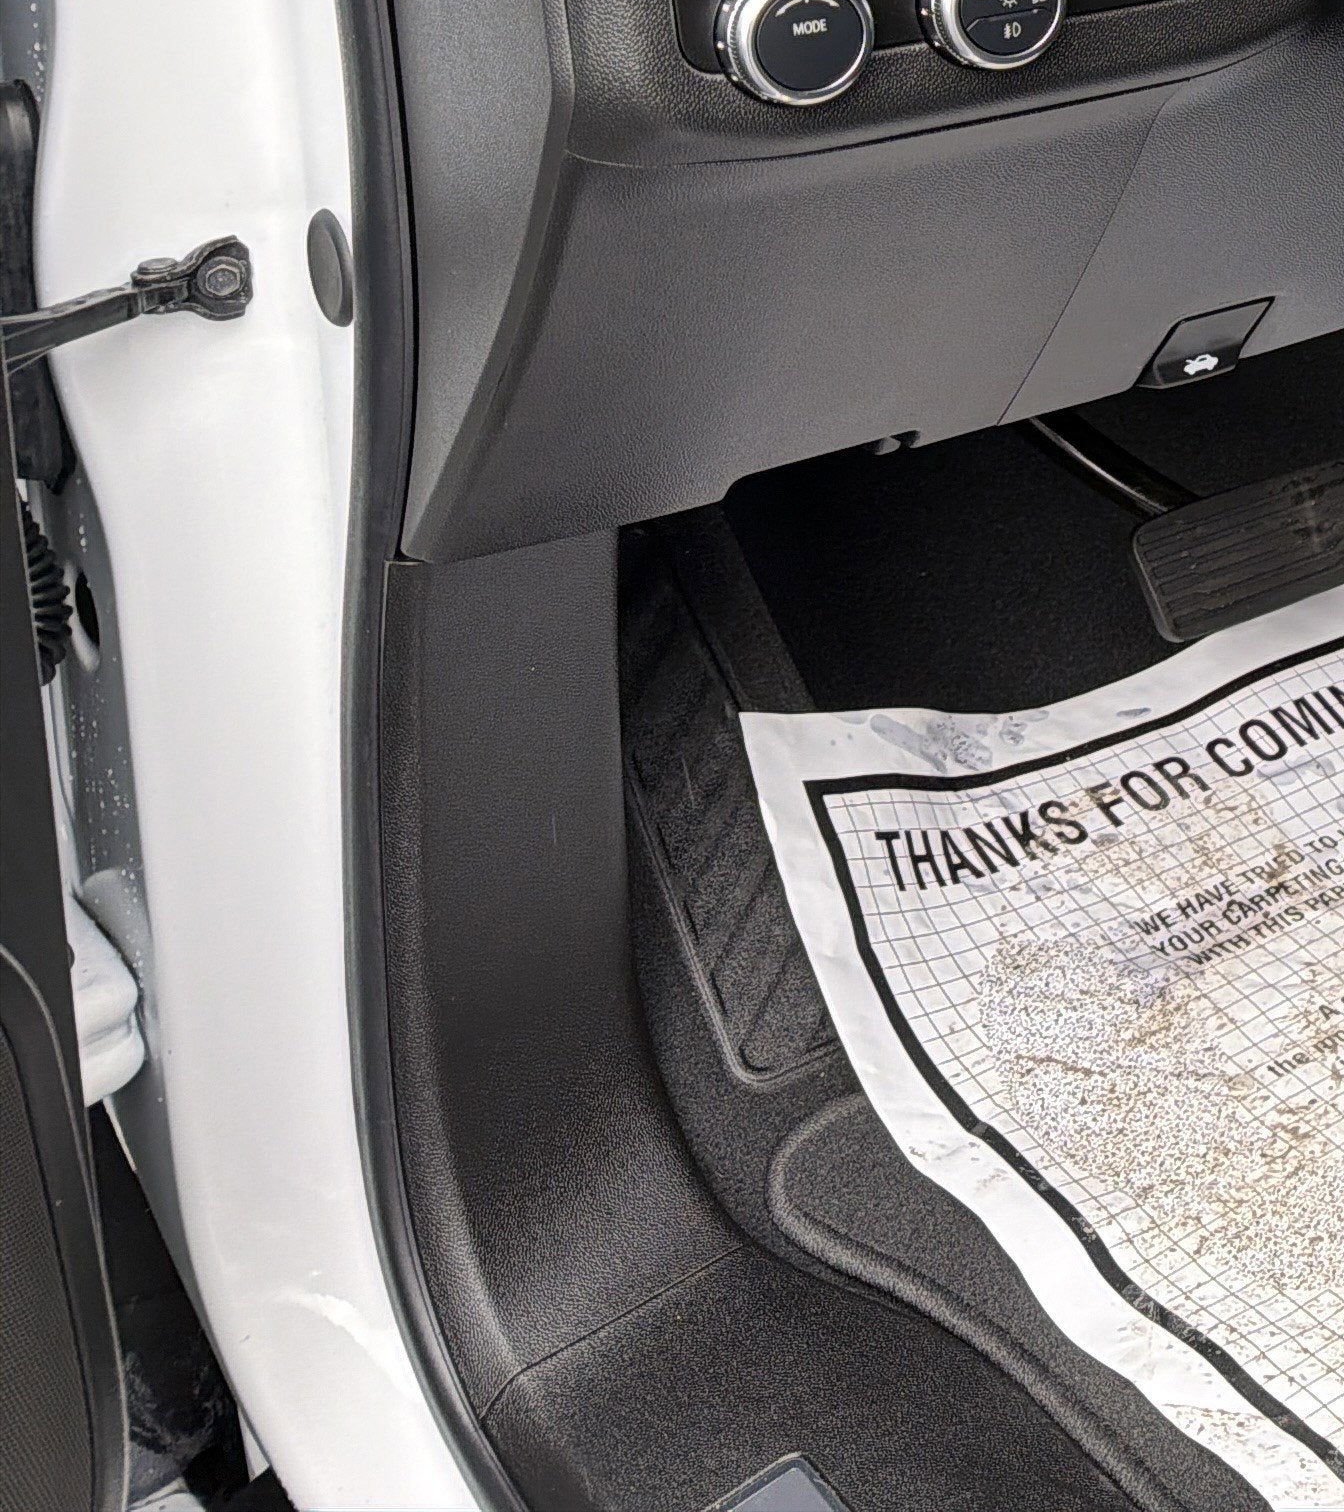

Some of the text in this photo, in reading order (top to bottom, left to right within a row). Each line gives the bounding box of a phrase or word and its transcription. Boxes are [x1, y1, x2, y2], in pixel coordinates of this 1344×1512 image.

[792, 18, 828, 37] MODE
[875, 800, 1089, 892] THANKS
[1087, 756, 1212, 828] FOR
[1132, 909, 1176, 936] WE
[1176, 878, 1240, 919] HAVE
[1235, 848, 1306, 885] TRIED
[1303, 835, 1338, 854] TO
[1151, 919, 1222, 957] YOUR
[1187, 933, 1251, 966] WITH
[1249, 905, 1306, 940] THIS
[1318, 1004, 1340, 1022] A
[1266, 1051, 1311, 1079] the
